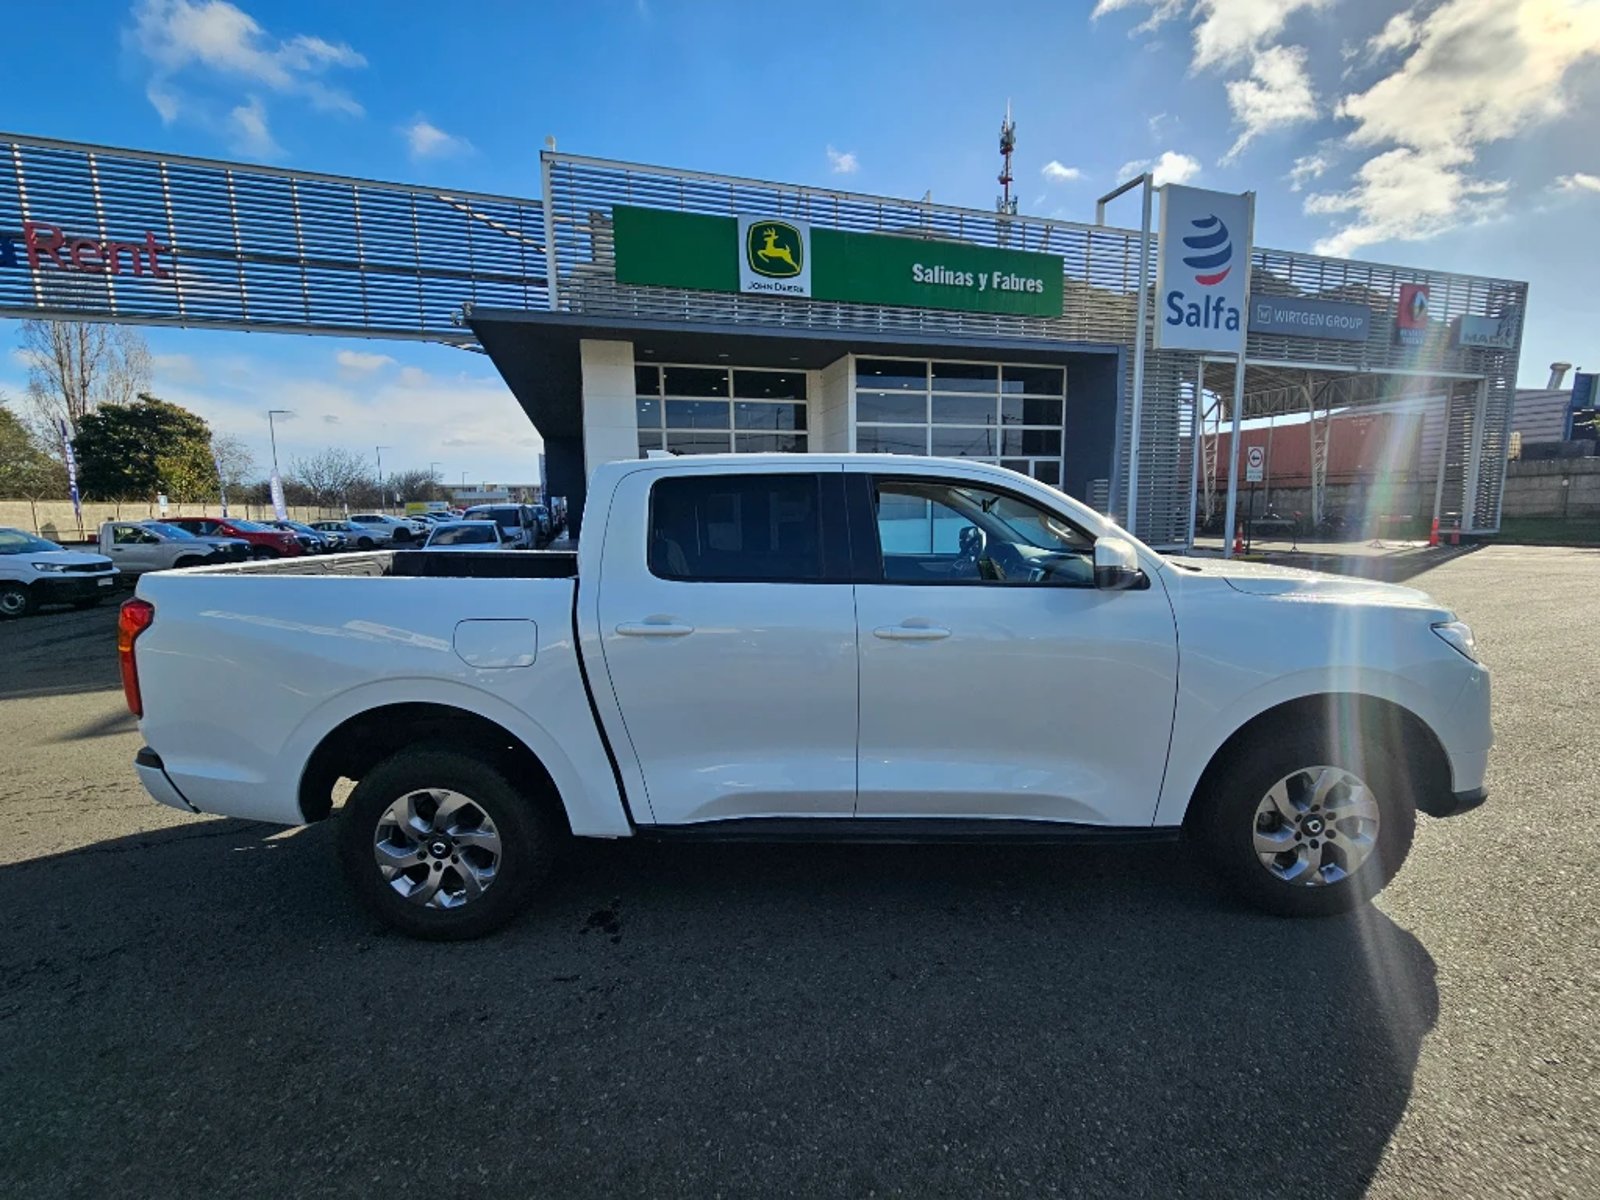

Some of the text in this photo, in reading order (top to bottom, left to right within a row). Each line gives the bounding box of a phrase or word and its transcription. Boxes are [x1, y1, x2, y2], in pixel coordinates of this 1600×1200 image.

[748, 281, 773, 290] JOHN
[912, 263, 1044, 293] Salinas y Fabres
[1166, 290, 1239, 331] Salfa
[1274, 308, 1364, 330] WIRTGEN GROUP
